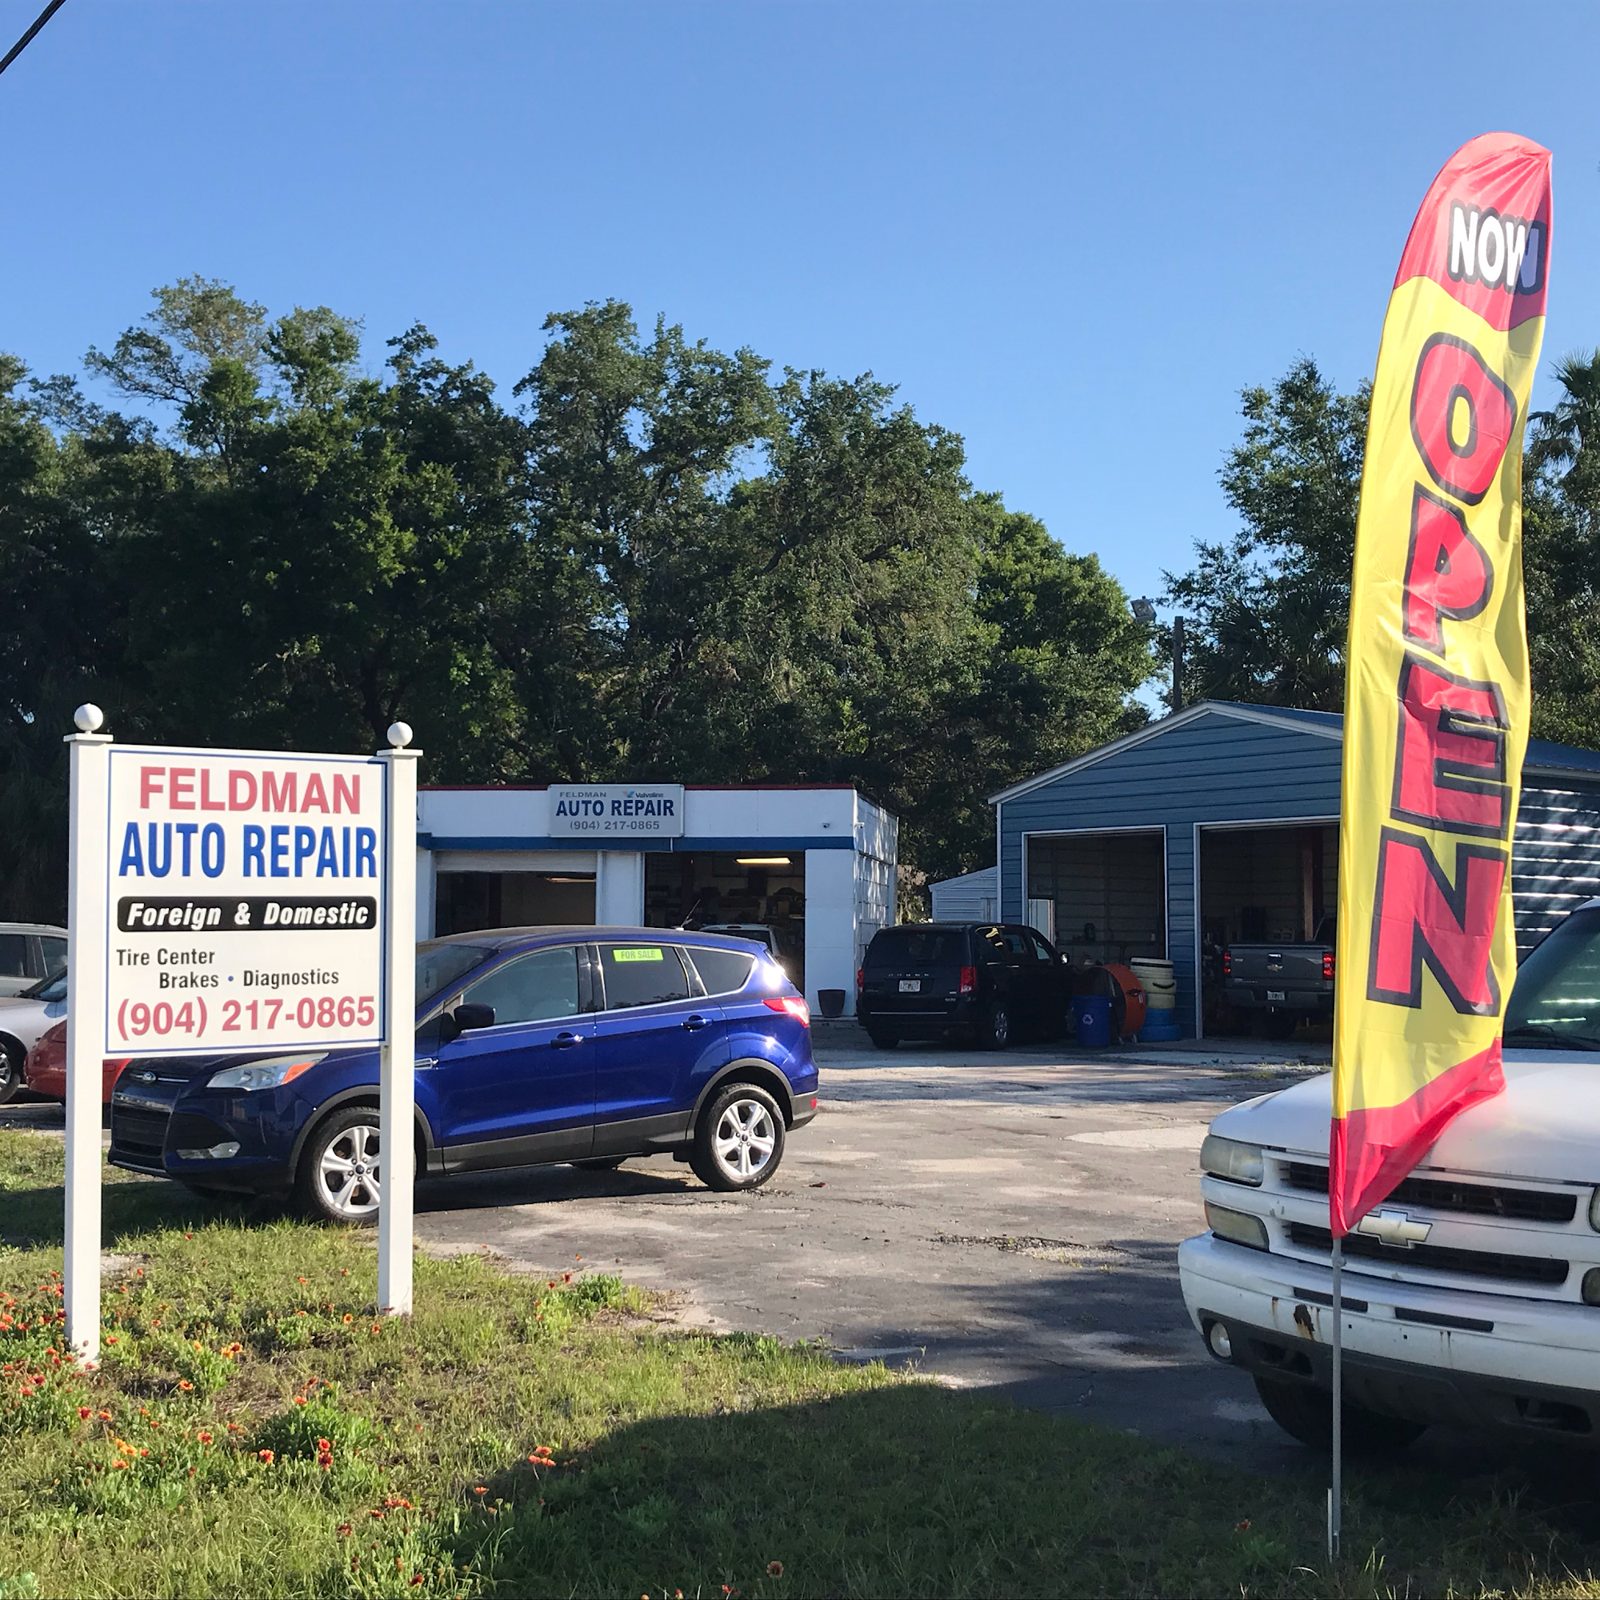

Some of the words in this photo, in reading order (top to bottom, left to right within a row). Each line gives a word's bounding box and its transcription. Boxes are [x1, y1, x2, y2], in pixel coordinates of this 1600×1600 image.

[1447, 199, 1548, 295] NOW
[1366, 331, 1516, 1017] OPEN
[139, 766, 361, 815] FELDMAN
[556, 800, 605, 817] AUTO
[611, 799, 675, 816] REPAIR
[570, 820, 600, 831] (904)
[604, 820, 660, 830] 217-0865
[118, 822, 226, 878] AUTO
[243, 825, 377, 878] REPAIR
[127, 903, 222, 931] Foreign
[234, 903, 251, 925] &
[263, 902, 369, 925] Domestic
[116, 949, 150, 966] Tire
[157, 948, 216, 965] Center
[620, 951, 636, 960] FOR
[637, 950, 656, 959] SALE
[159, 971, 219, 989] Brakes
[243, 969, 340, 990] Diagnostics
[117, 996, 208, 1041] (904)
[222, 996, 375, 1032] 217-0865
